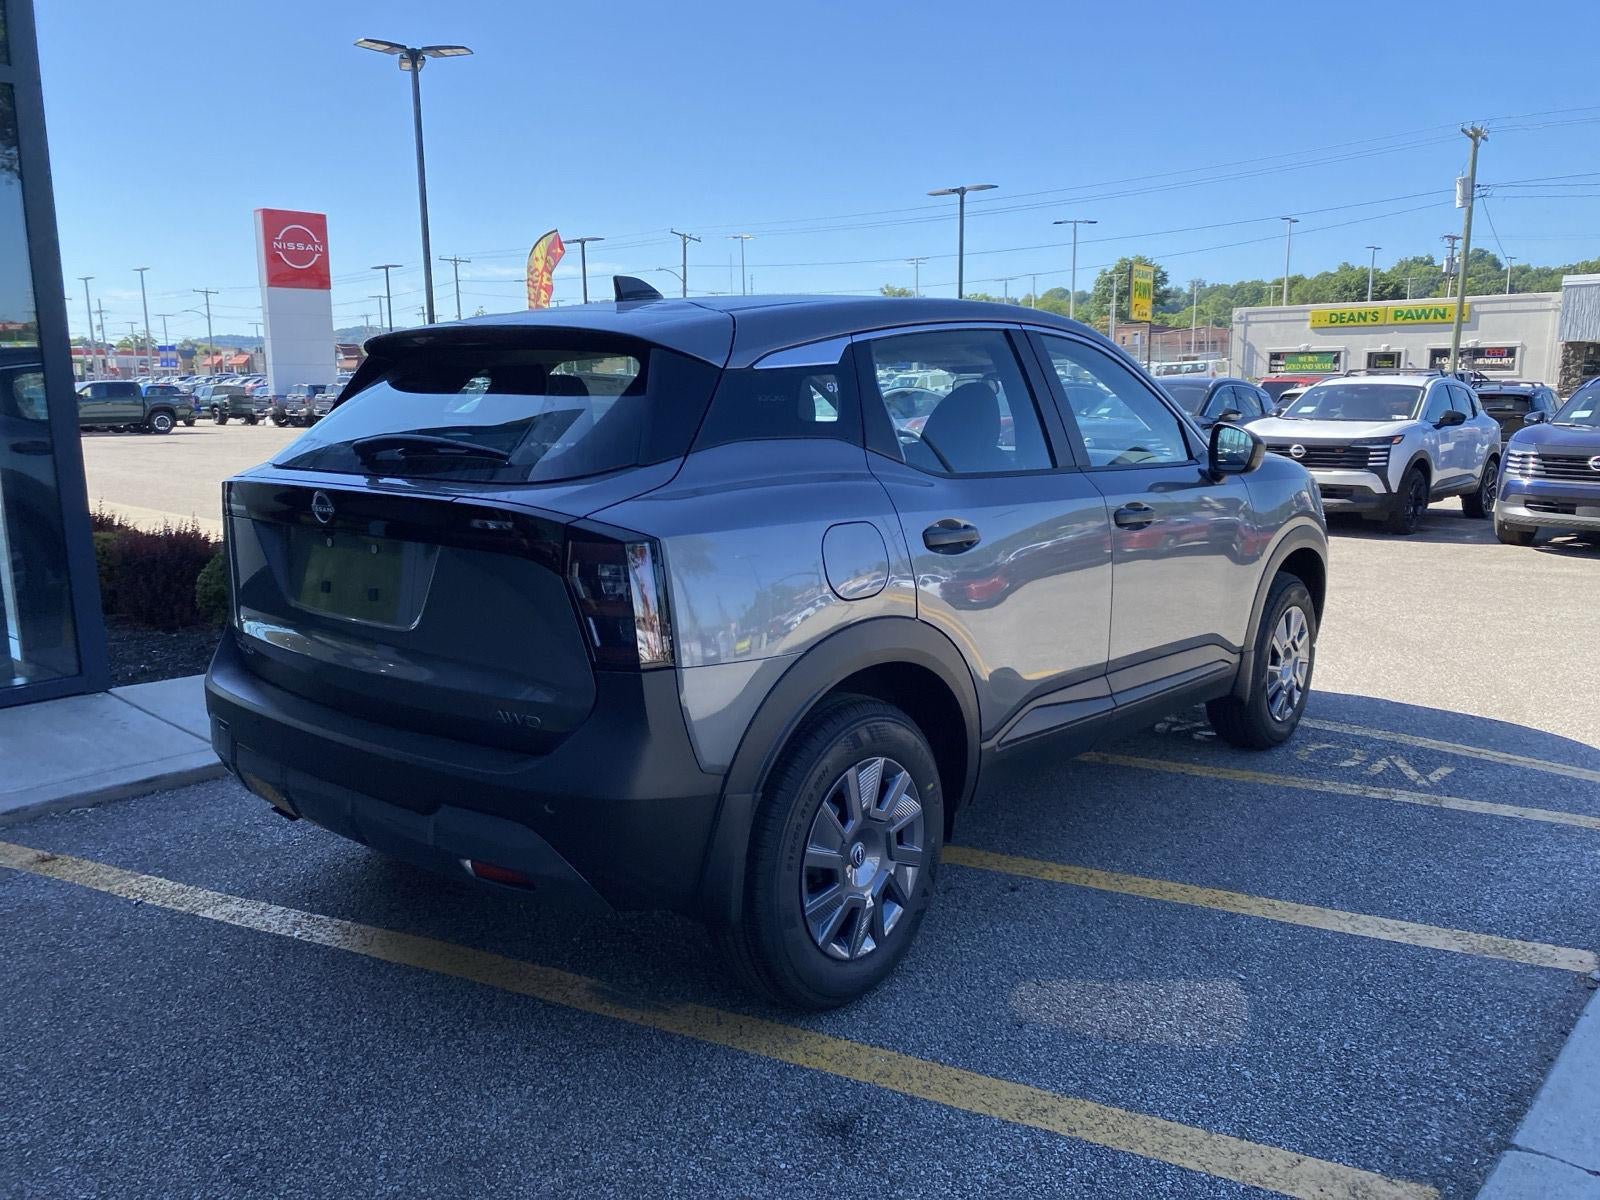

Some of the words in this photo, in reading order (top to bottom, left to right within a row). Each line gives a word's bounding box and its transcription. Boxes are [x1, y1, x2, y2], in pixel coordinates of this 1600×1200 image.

[273, 241, 323, 252] NISSAN
[1134, 281, 1152, 299] PAWN
[1329, 310, 1379, 324] DEAN'S
[1393, 307, 1447, 321] PAWN
[1436, 356, 1461, 364] LON
[1475, 357, 1514, 365] JEWELRY
[1444, 363, 1468, 371] SLL
